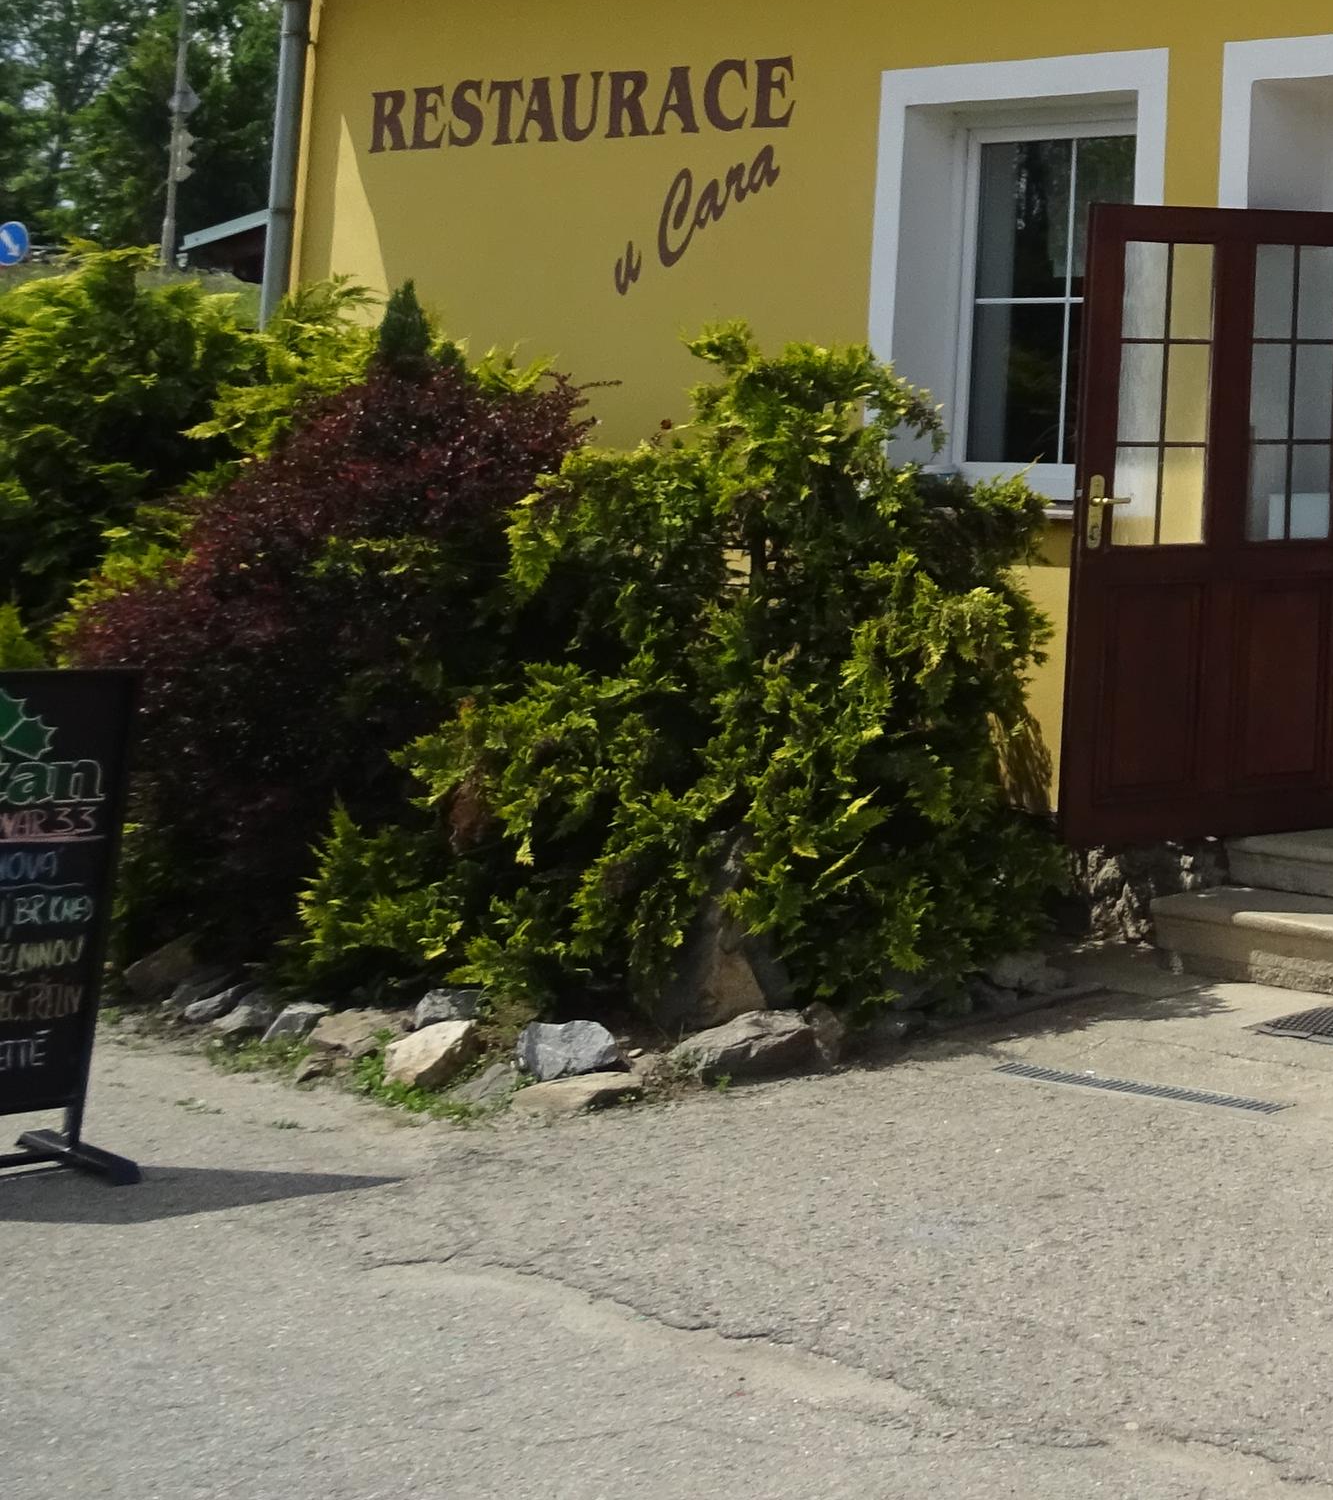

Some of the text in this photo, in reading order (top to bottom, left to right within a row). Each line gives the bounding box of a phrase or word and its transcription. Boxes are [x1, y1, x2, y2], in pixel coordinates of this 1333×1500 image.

[368, 55, 797, 154] RESTAURACE
[615, 144, 781, 296] u Cara
